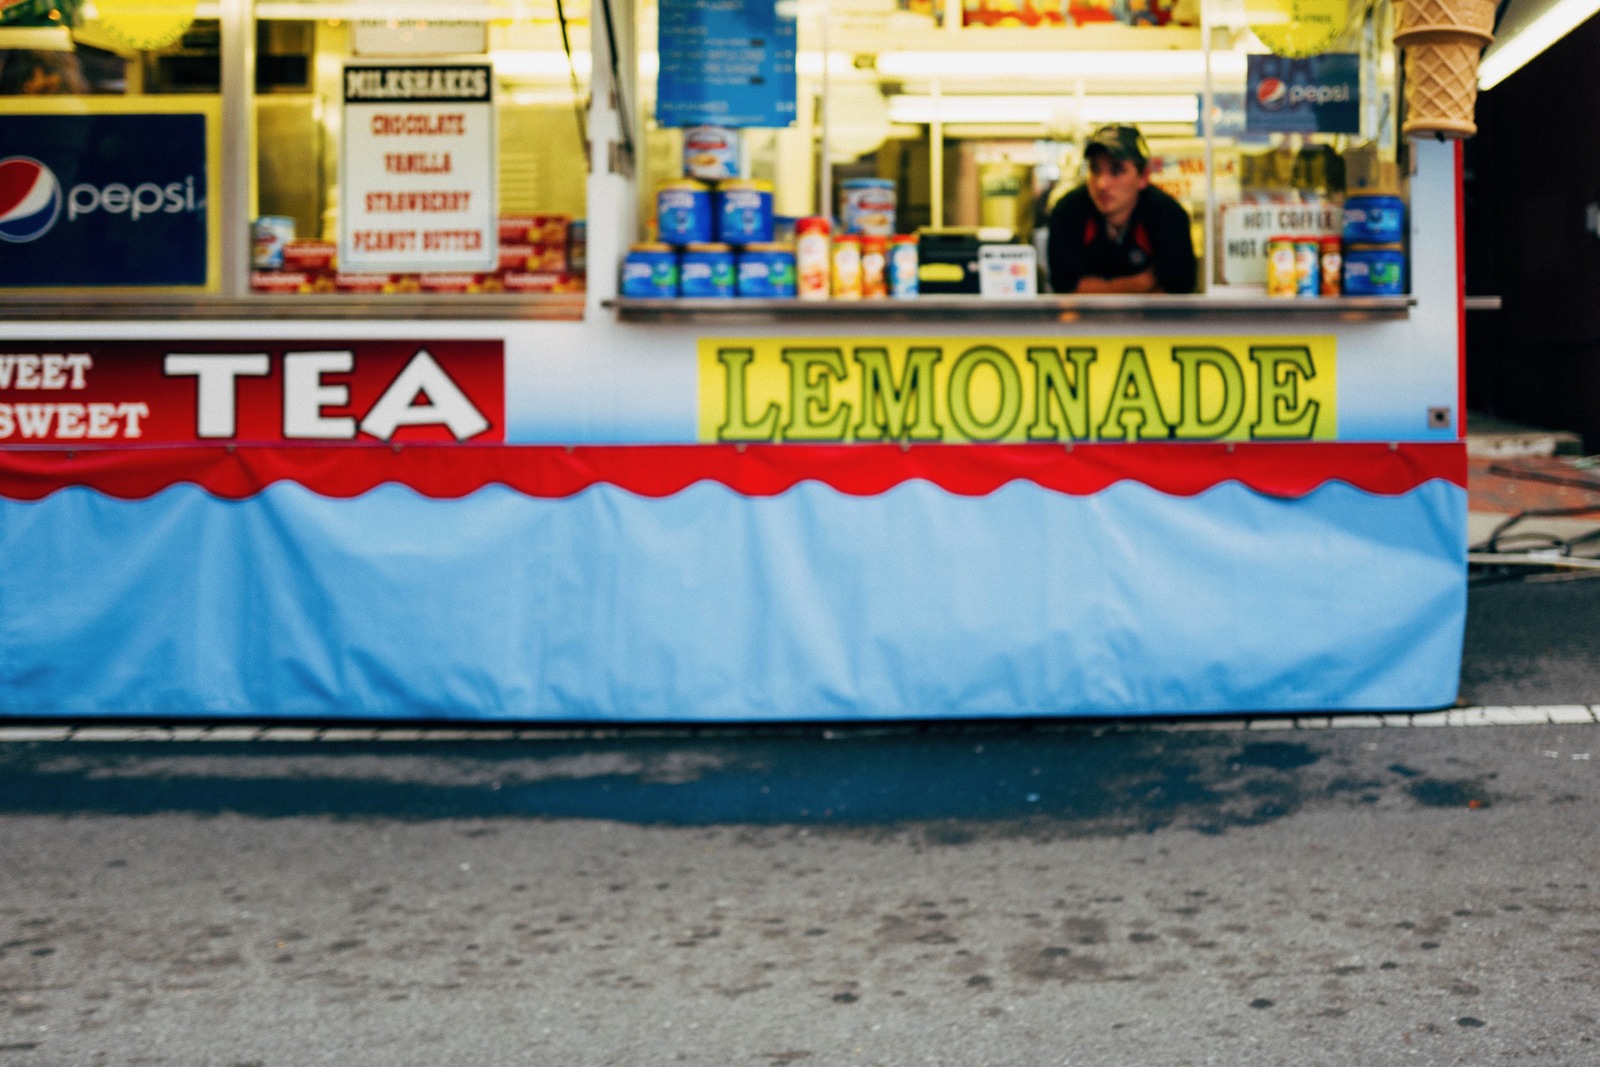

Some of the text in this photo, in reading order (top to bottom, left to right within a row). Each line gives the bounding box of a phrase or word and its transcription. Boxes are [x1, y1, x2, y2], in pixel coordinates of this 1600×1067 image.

[346, 69, 488, 98] MILKSHAKES
[1289, 83, 1349, 106] pepsi
[372, 114, 466, 135] CHOCOLATE
[67, 175, 195, 222] pepsi
[1243, 210, 1272, 229] HOT
[354, 230, 416, 252] PEANUT
[423, 230, 482, 252] BUTTER
[1228, 237, 1257, 257] HOT
[163, 348, 493, 442] TEA
[716, 344, 1320, 442] LEMONADE
